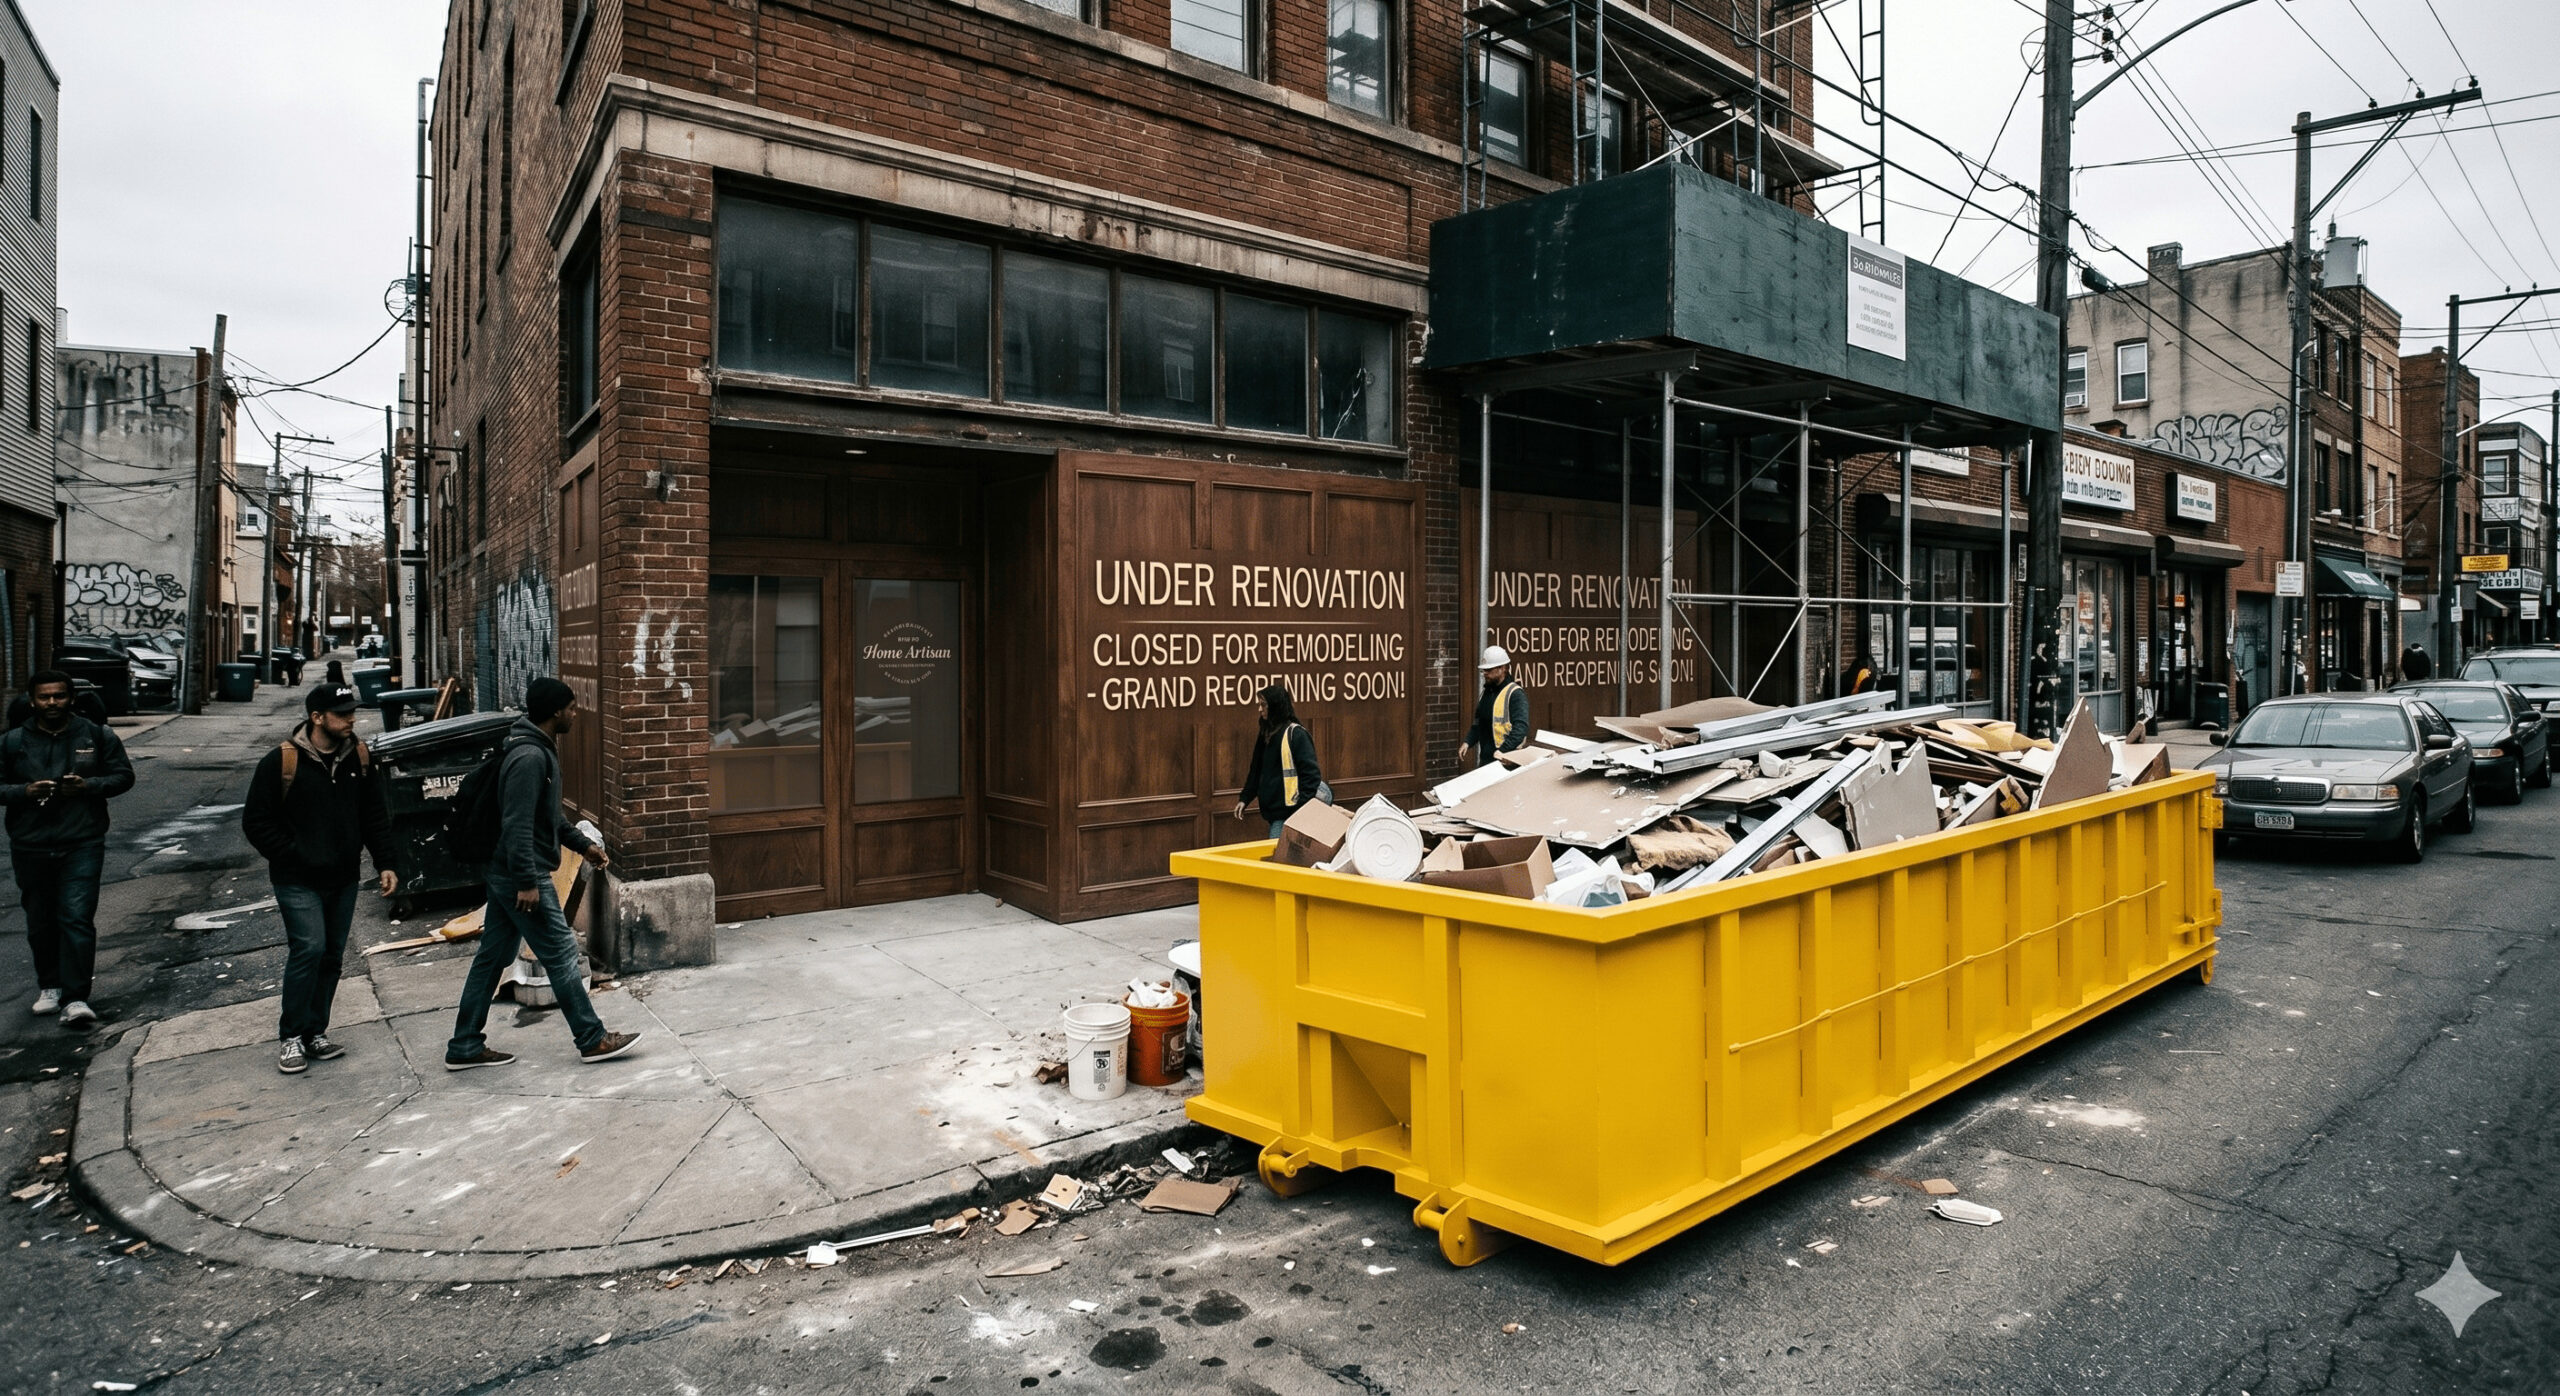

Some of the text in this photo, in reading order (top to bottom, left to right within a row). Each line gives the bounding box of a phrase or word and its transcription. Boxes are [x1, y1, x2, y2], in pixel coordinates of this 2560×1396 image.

[1096, 560, 1404, 609] UNDER RENOVATION
[863, 643, 951, 660] Home Artisan
[1093, 633, 1404, 666] CLOSED FOR REMODELING
[1559, 627, 1590, 652] FOR
[1648, 659, 1694, 683] SON!
[1343, 671, 1405, 700] SOON!
